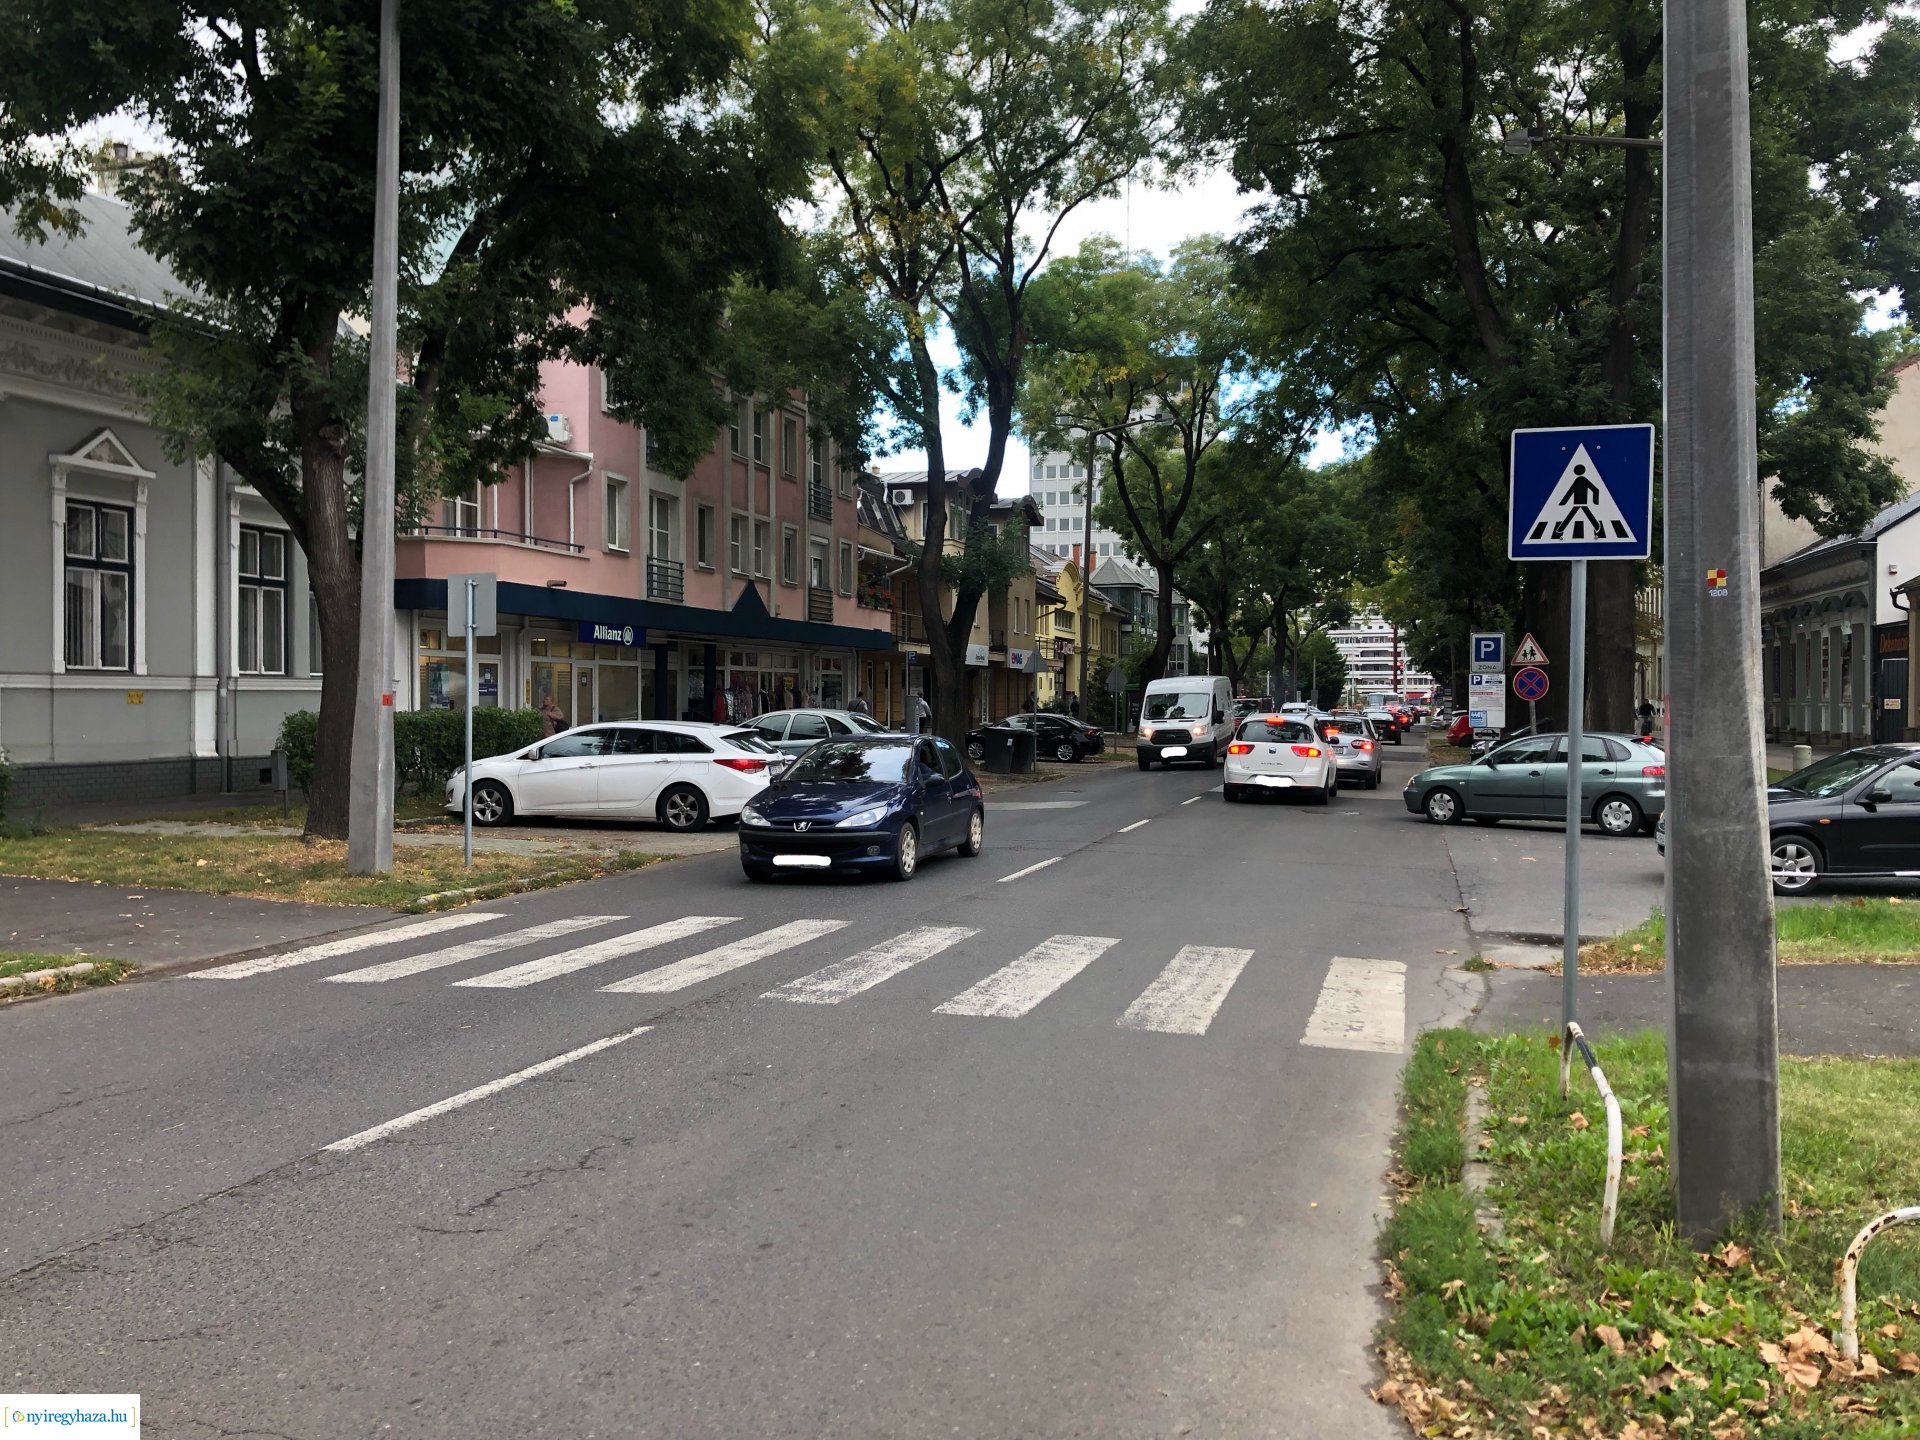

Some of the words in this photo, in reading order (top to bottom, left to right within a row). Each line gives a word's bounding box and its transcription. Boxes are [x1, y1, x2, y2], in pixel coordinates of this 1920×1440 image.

[593, 624, 622, 641] Allianz
[1480, 640, 1495, 659] P
[1473, 675, 1481, 685] P
